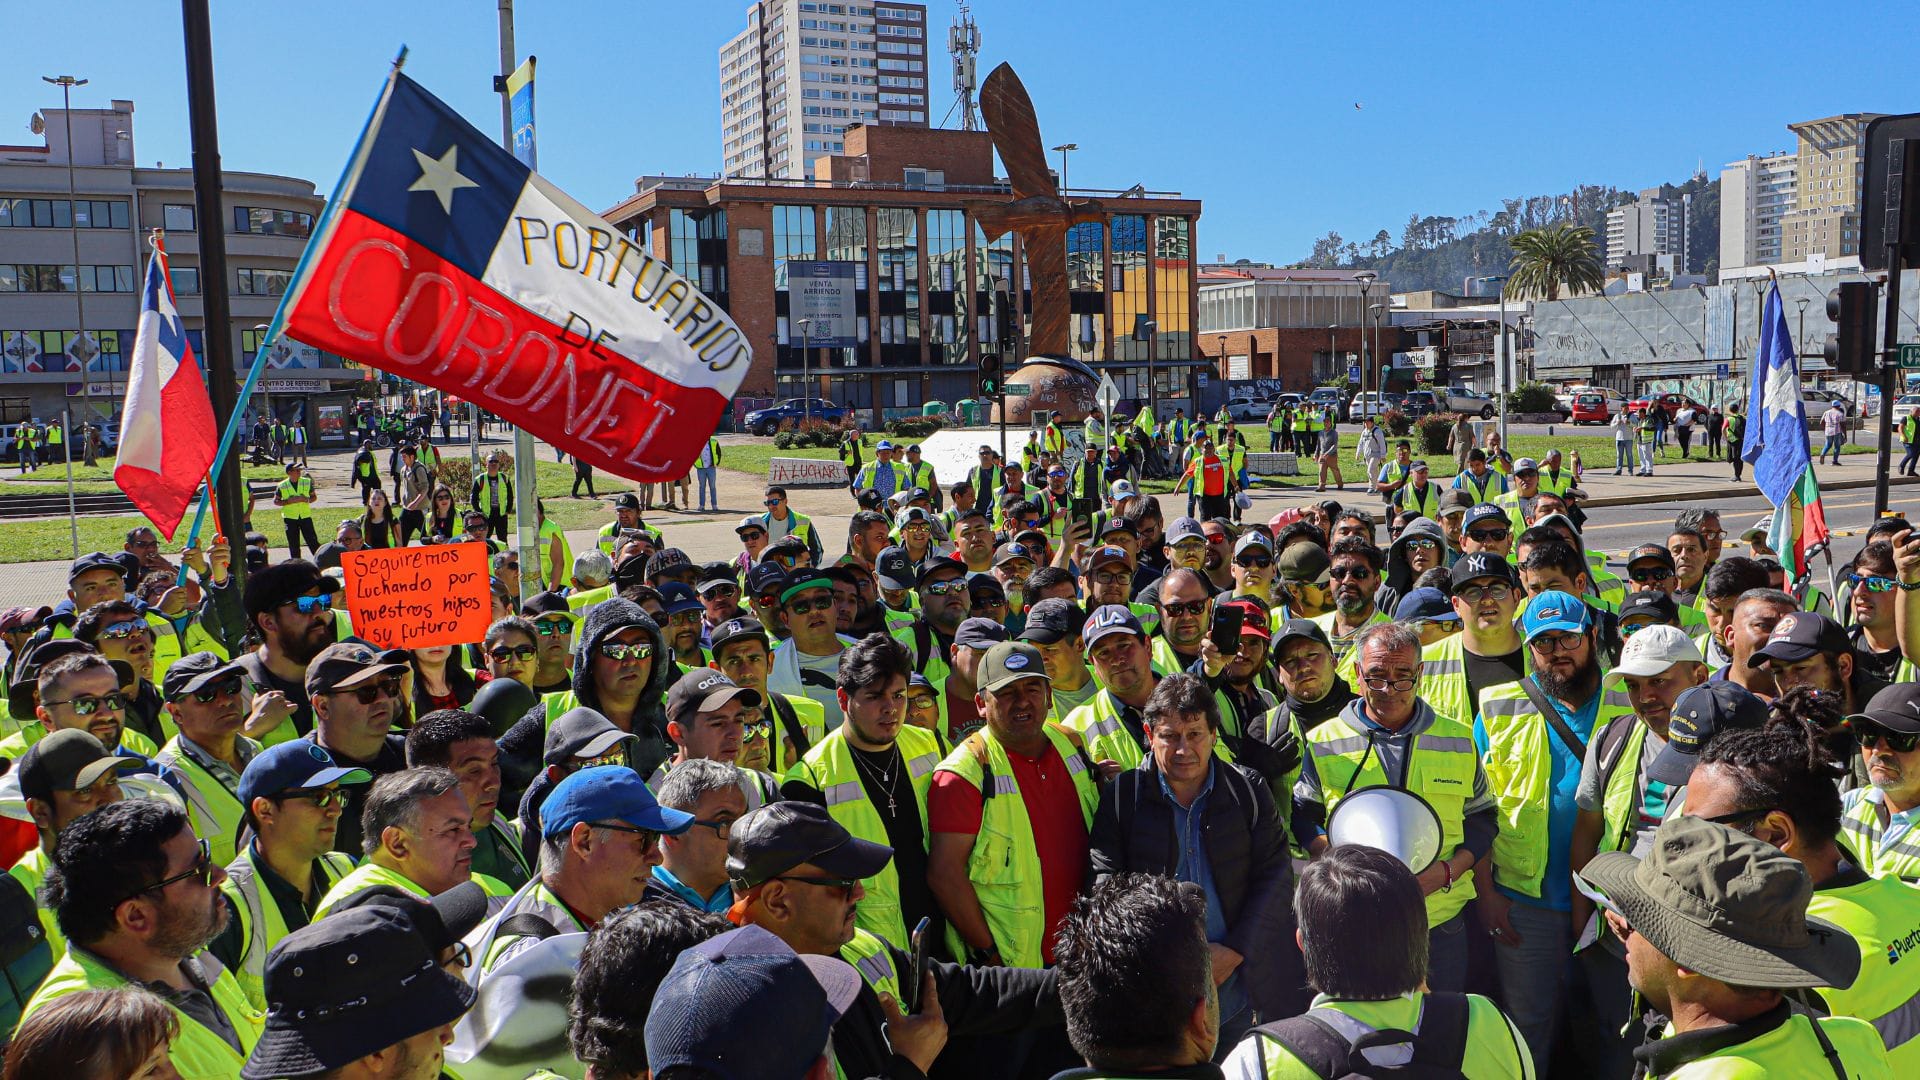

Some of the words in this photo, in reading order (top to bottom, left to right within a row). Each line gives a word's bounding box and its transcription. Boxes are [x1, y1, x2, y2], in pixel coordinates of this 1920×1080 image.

[515, 216, 750, 371] PORTUARIOS
[809, 280, 833, 288] VENTA
[556, 310, 620, 361] DE
[328, 237, 675, 473] CORONEL
[354, 550, 460, 580] Seguiremos
[1467, 554, 1487, 572] NY
[357, 572, 432, 599] Luchando
[448, 572, 478, 592] por
[360, 600, 433, 624] nuestros
[443, 596, 481, 617] hijos
[373, 628, 392, 643] su
[402, 620, 458, 643] futuro
[1085, 611, 1126, 637] FILA
[698, 674, 731, 690] adid
[1892, 928, 1920, 958] Puerto
